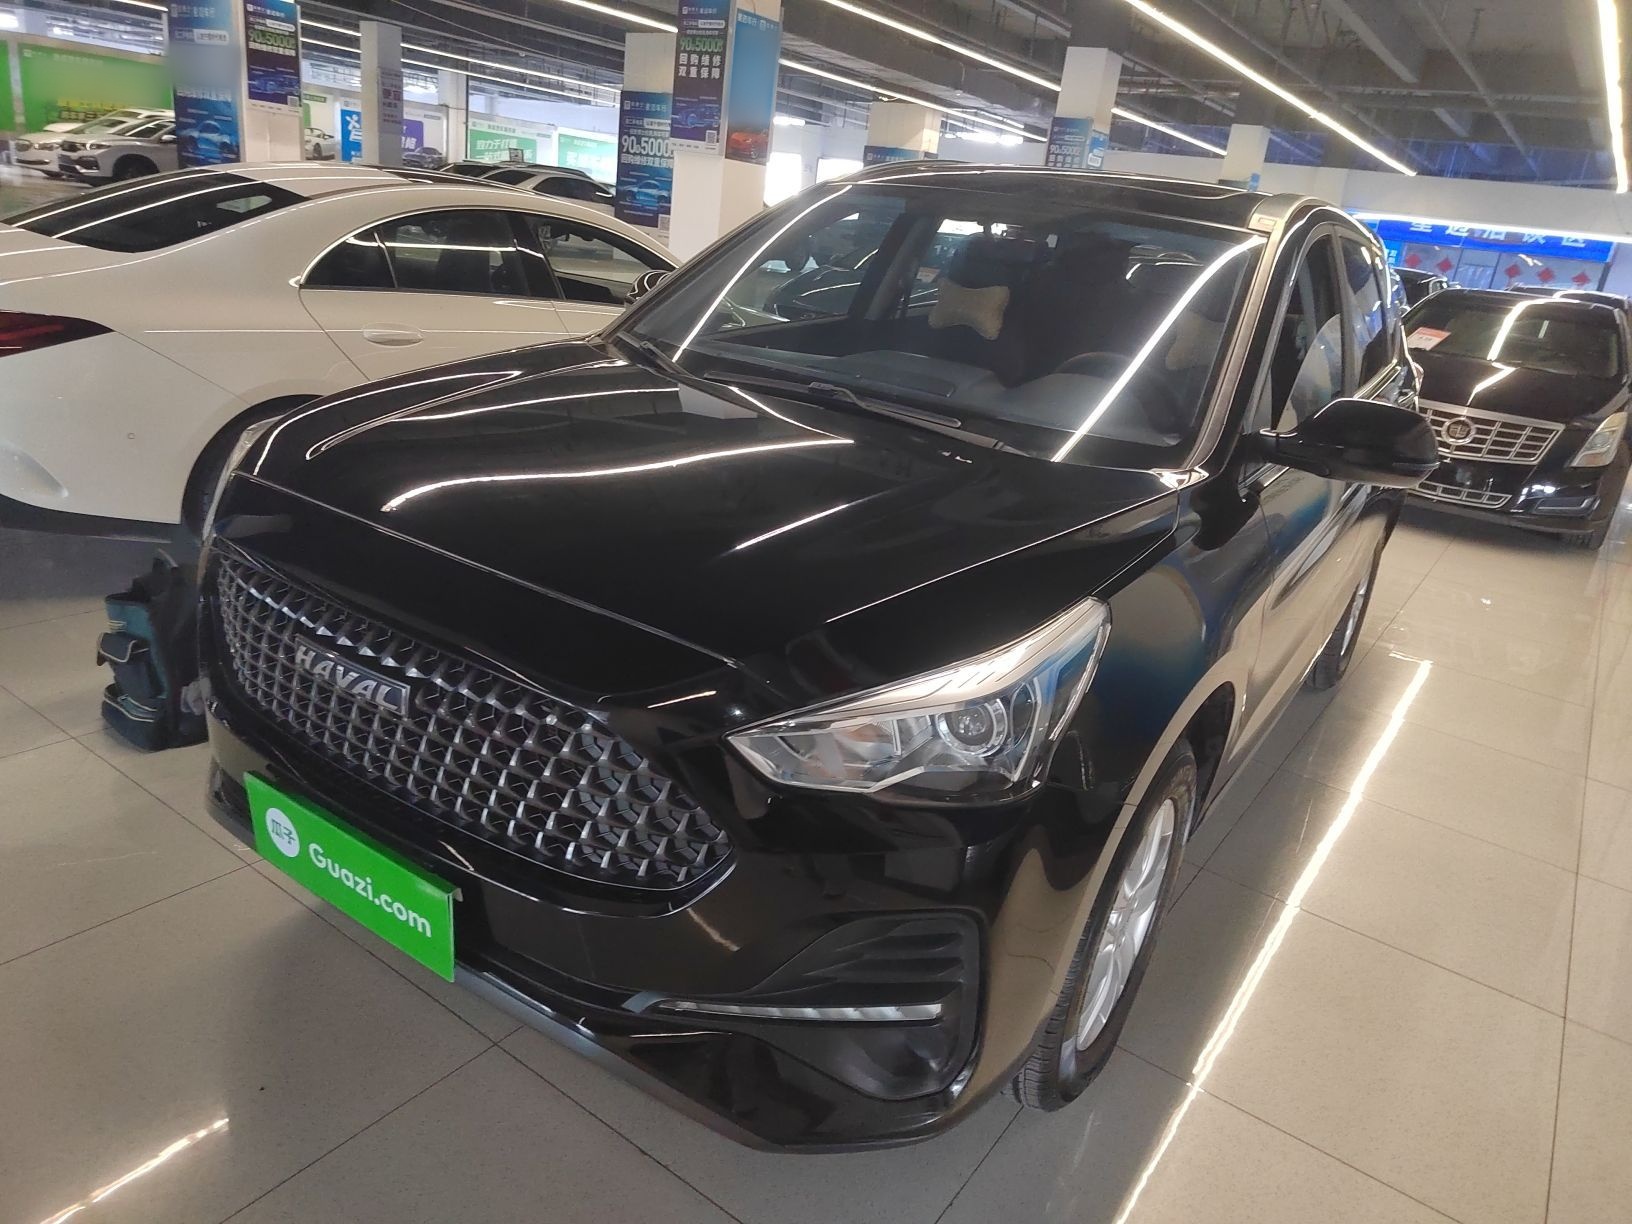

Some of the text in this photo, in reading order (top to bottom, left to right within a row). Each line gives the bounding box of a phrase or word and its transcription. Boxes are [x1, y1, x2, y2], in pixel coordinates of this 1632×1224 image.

[678, 66, 720, 79] 双重保障
[679, 53, 721, 67] 回购维修
[295, 645, 399, 711] HAVAL
[308, 842, 432, 938] Guazi.com
